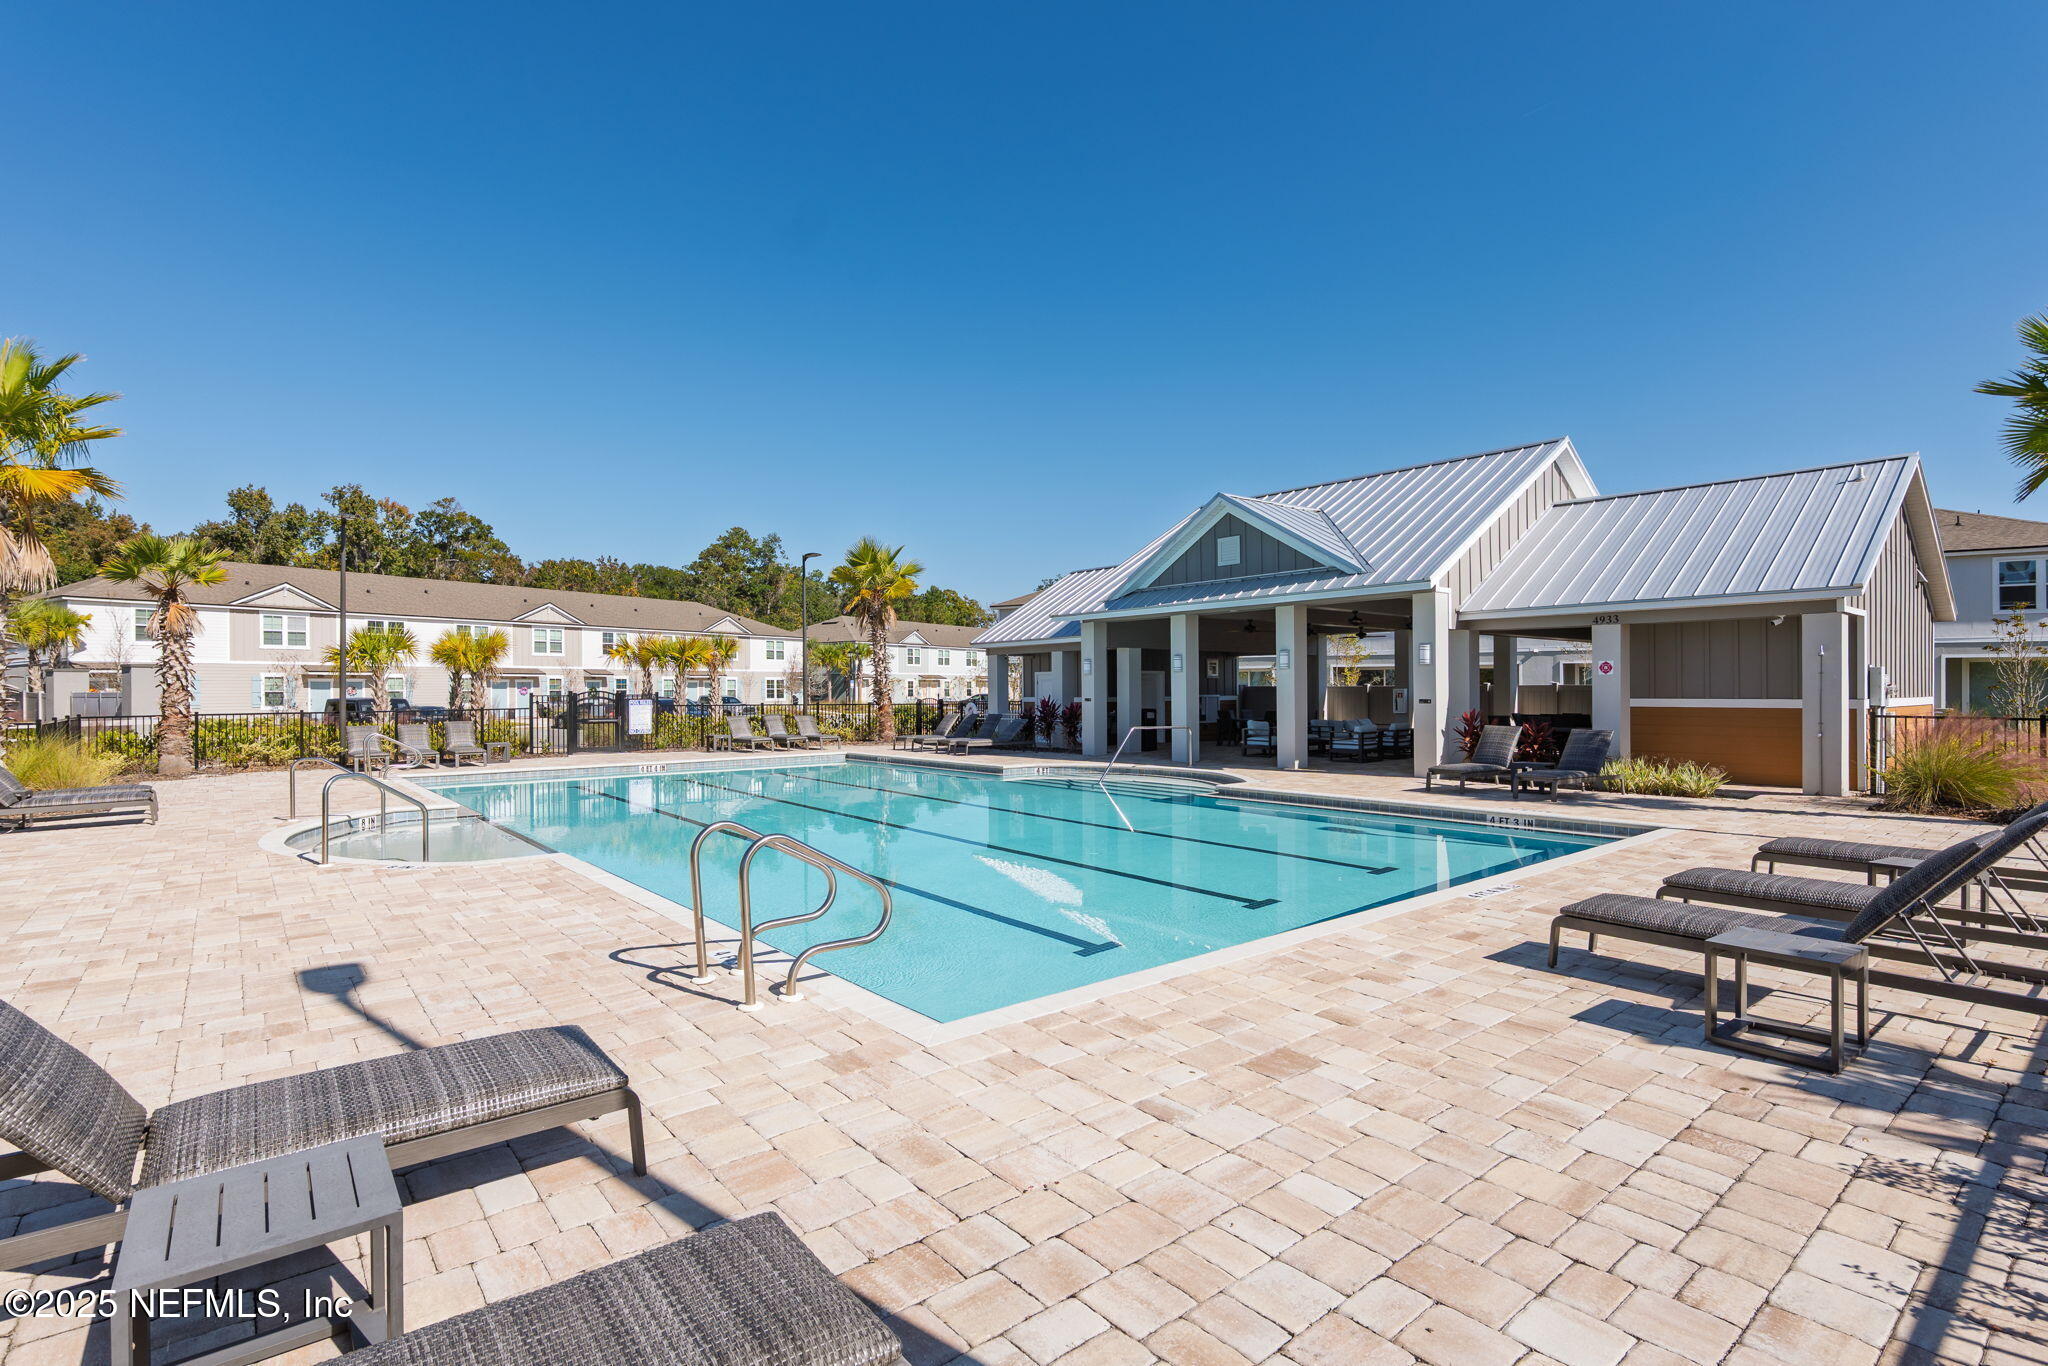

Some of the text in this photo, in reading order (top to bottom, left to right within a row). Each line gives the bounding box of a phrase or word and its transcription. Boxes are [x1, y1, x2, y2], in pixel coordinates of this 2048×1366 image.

[1592, 614, 1620, 625] 4933
[1490, 816, 1534, 827] 4 FT 3 IN
